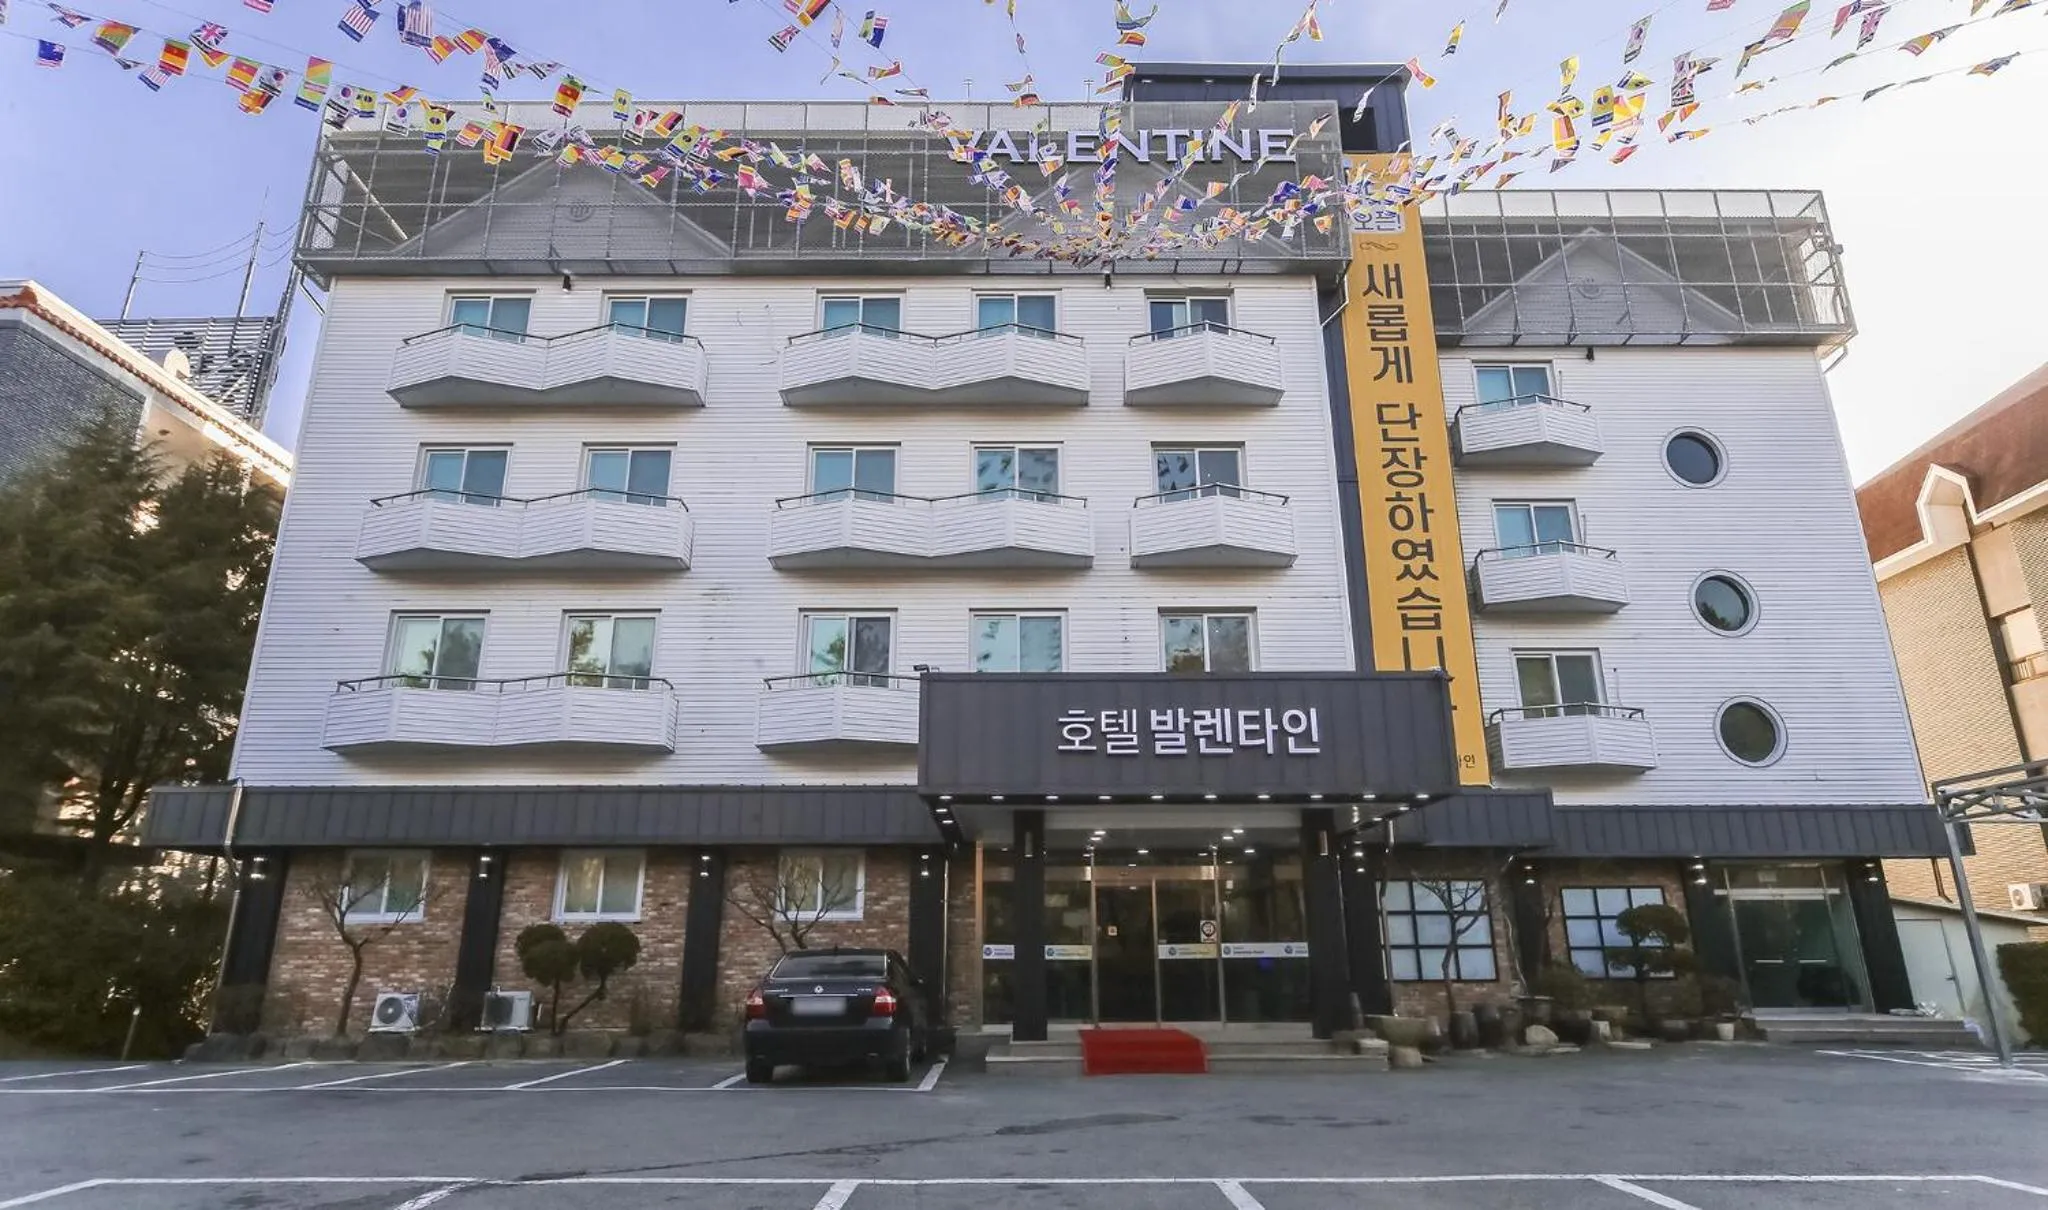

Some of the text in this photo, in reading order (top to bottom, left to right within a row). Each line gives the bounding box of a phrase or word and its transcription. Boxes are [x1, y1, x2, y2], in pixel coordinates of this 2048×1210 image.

[1362, 263, 1414, 385] 새롭게
[1376, 402, 1457, 711] 단장하였습니
[1057, 707, 1321, 755] 호텔 발렌타인
